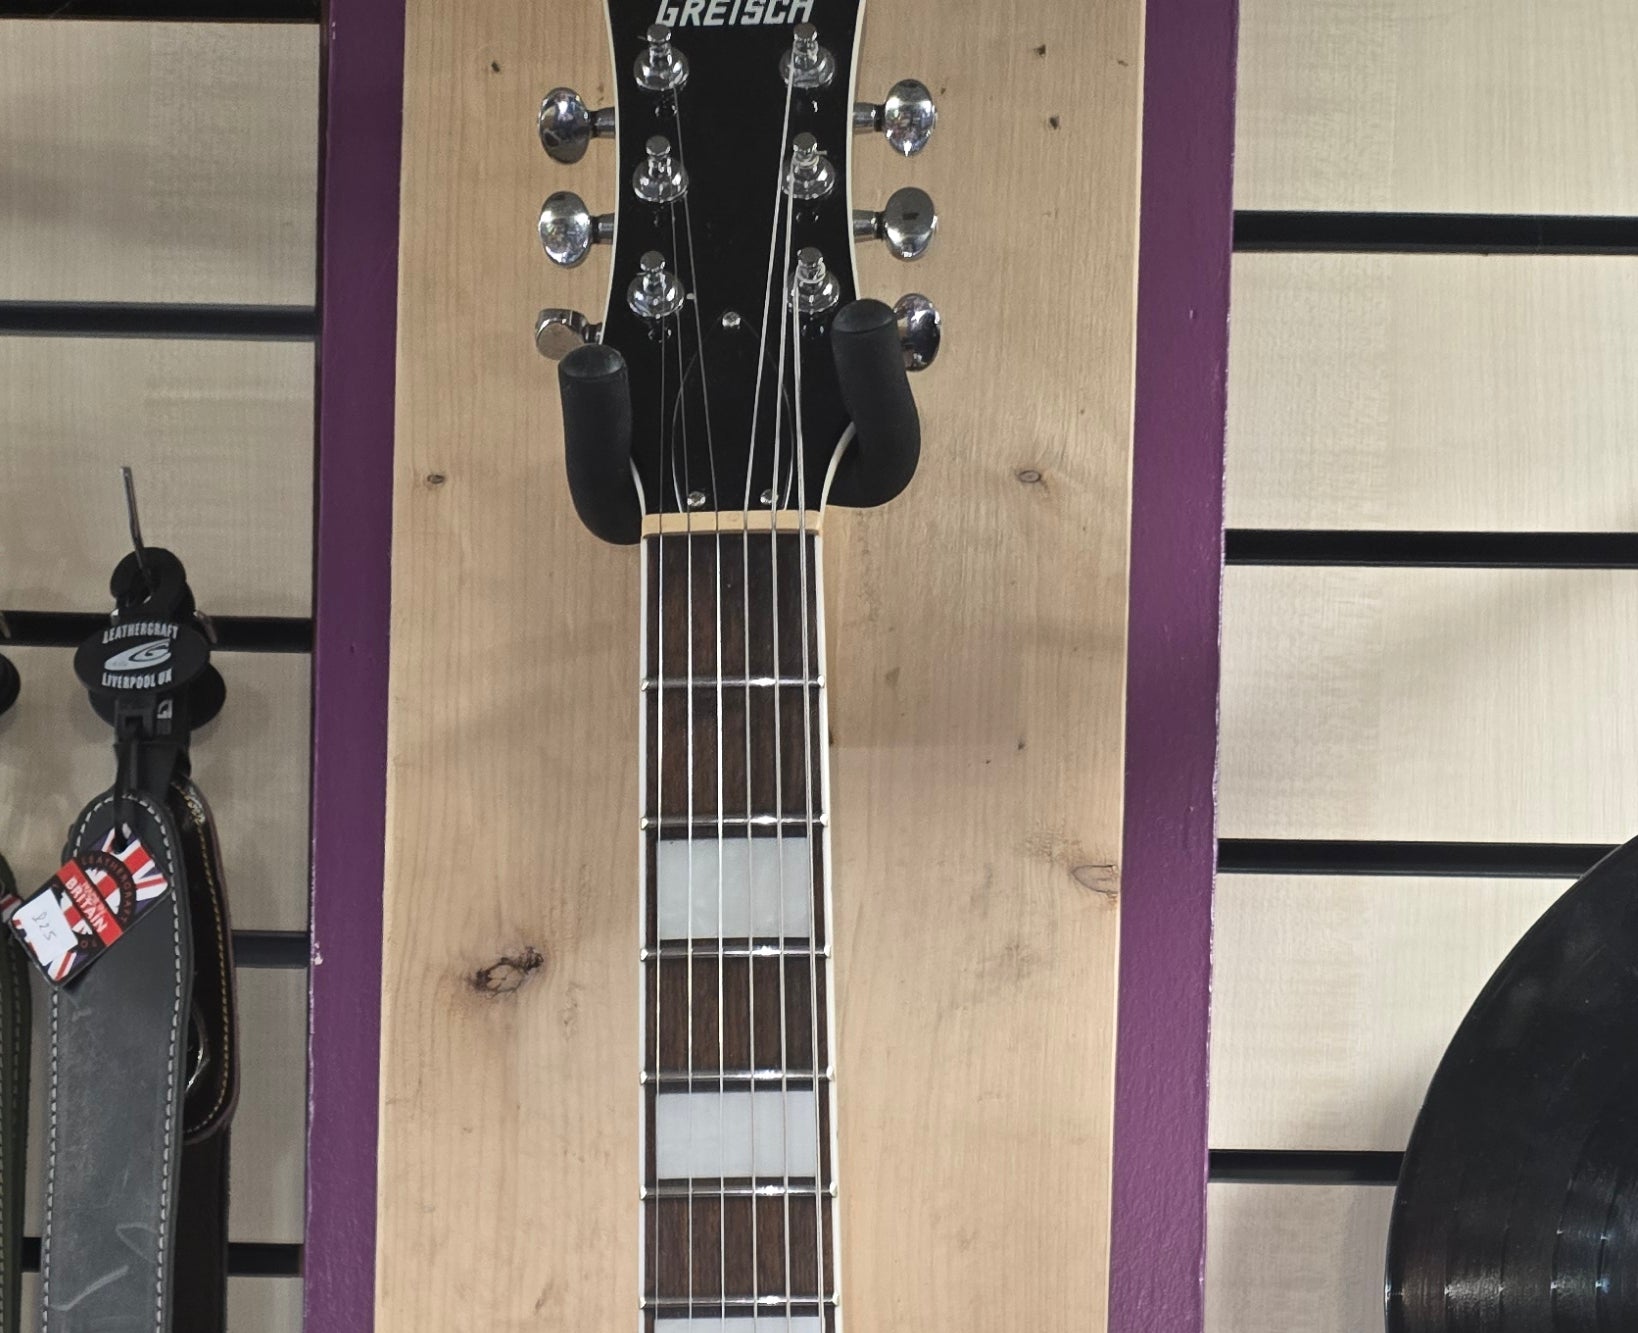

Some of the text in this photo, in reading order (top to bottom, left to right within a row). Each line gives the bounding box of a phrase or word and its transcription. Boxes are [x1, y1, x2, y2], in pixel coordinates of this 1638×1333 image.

[657, 0, 814, 27] GRETSCH
[102, 622, 179, 645] LEATHERCRAFT
[101, 668, 173, 690] LIVERPOOL UK
[65, 877, 108, 933] BRITAIN
